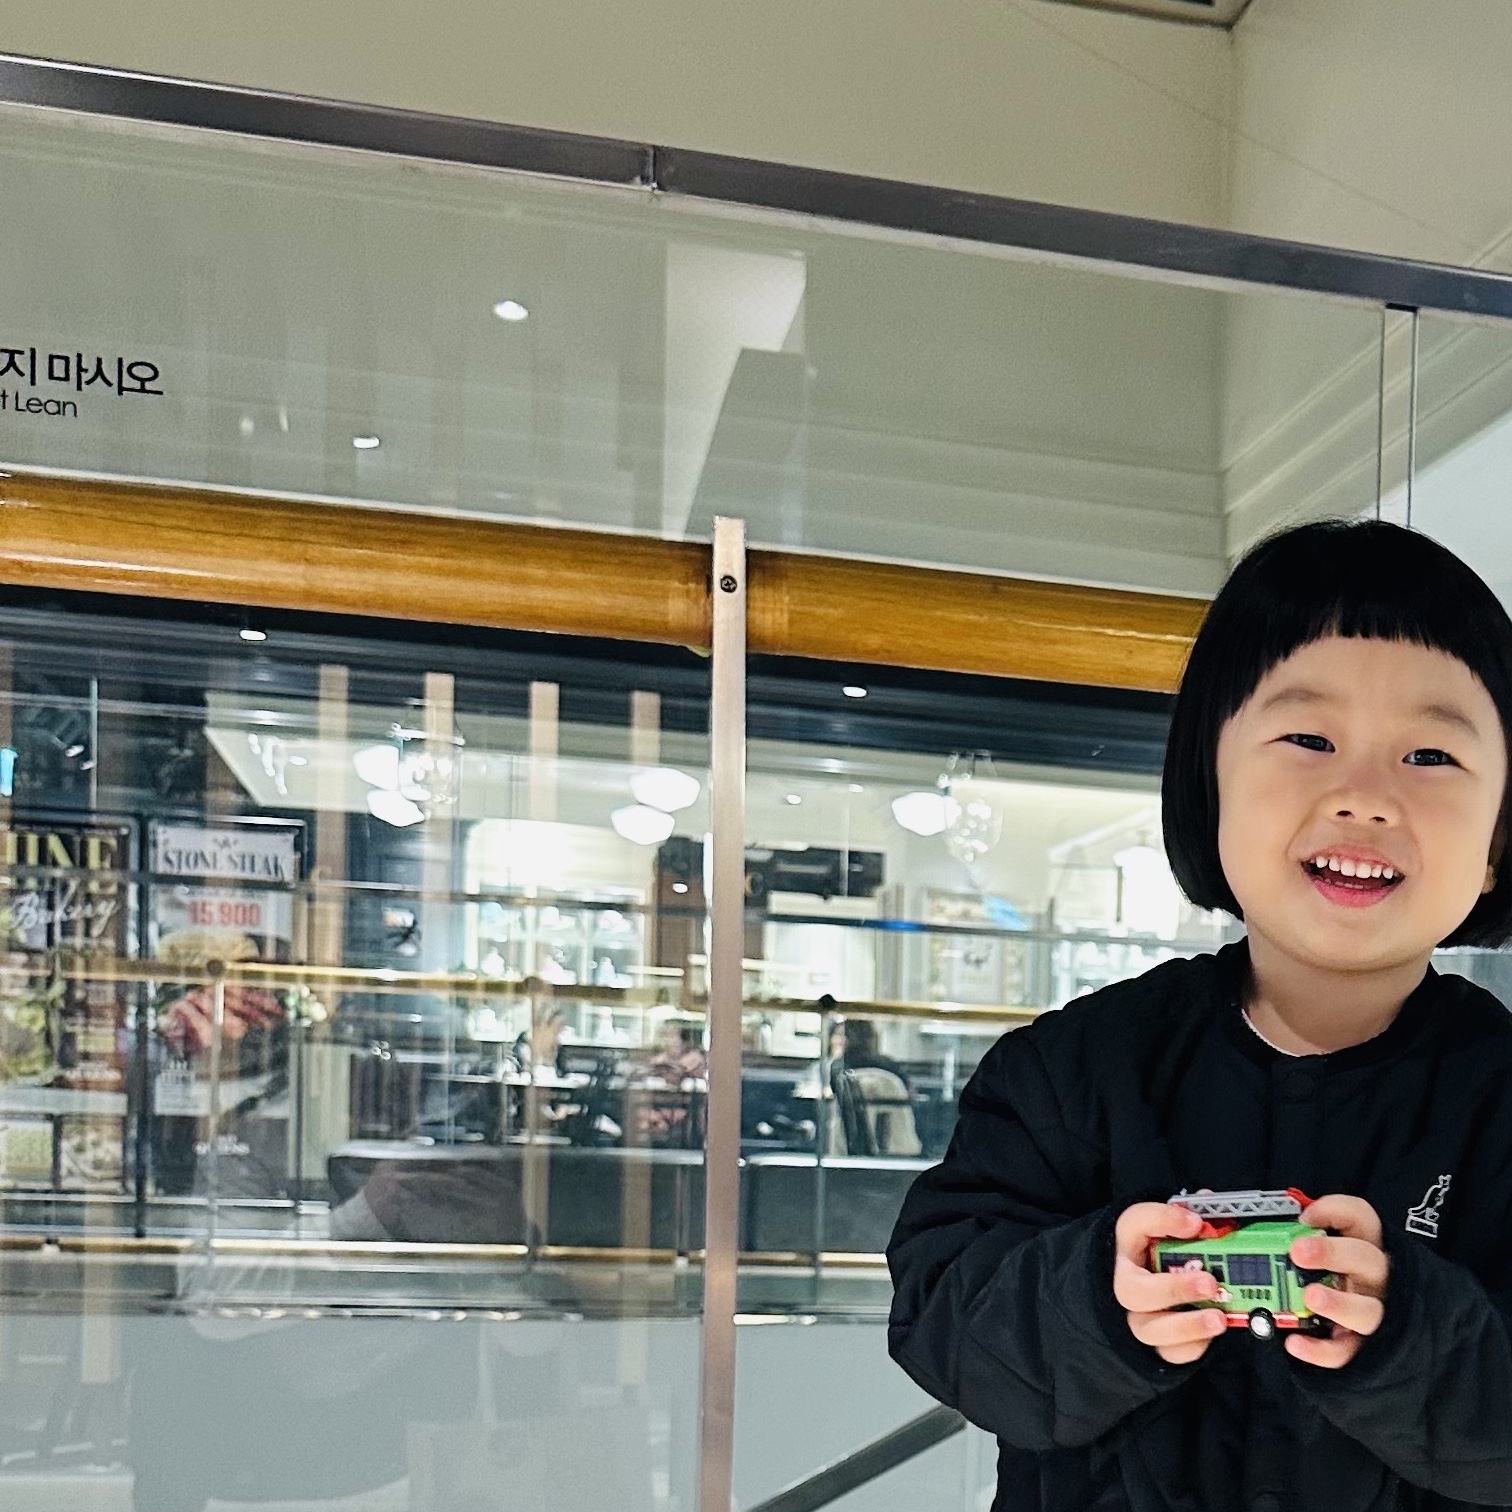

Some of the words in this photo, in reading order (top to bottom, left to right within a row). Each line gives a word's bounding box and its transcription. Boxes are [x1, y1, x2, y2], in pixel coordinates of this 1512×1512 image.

[0, 347, 37, 387] 지
[48, 352, 164, 396] 마시오
[15, 391, 78, 418] Lean
[163, 849, 218, 874] STONE
[227, 853, 286, 882] STEAK
